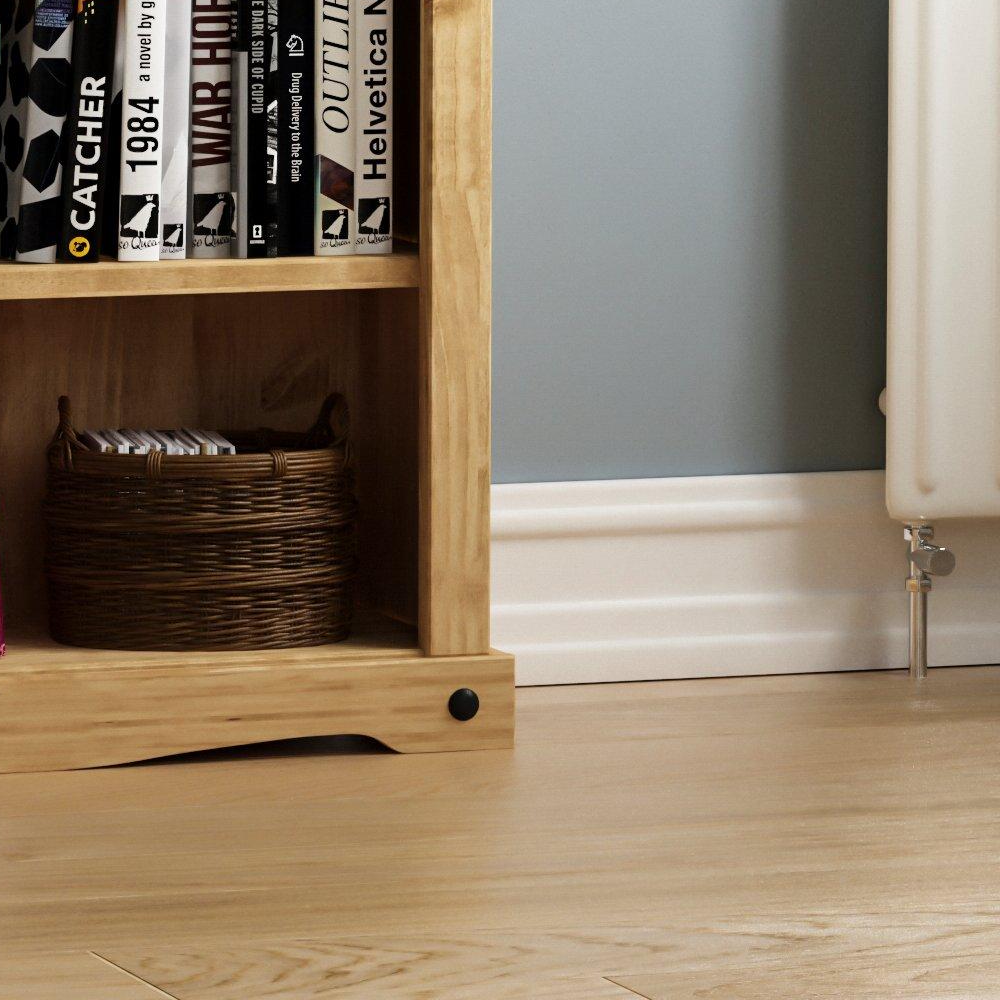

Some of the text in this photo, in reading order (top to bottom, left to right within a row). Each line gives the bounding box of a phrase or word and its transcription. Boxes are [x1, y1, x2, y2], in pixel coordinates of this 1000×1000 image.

[138, 13, 156, 30] by
[251, 10, 265, 37] DARK
[138, 32, 152, 70] novel
[251, 40, 265, 63] SIDE
[140, 73, 150, 82] a
[251, 67, 265, 80] OF
[251, 83, 264, 114] CUPID
[363, 28, 388, 181] Helvetica
[126, 96, 160, 173] 1984
[192, 81, 231, 168] WAR
[288, 72, 303, 182] Drug Delivery to the Brain
[69, 75, 107, 231] CATCHER
